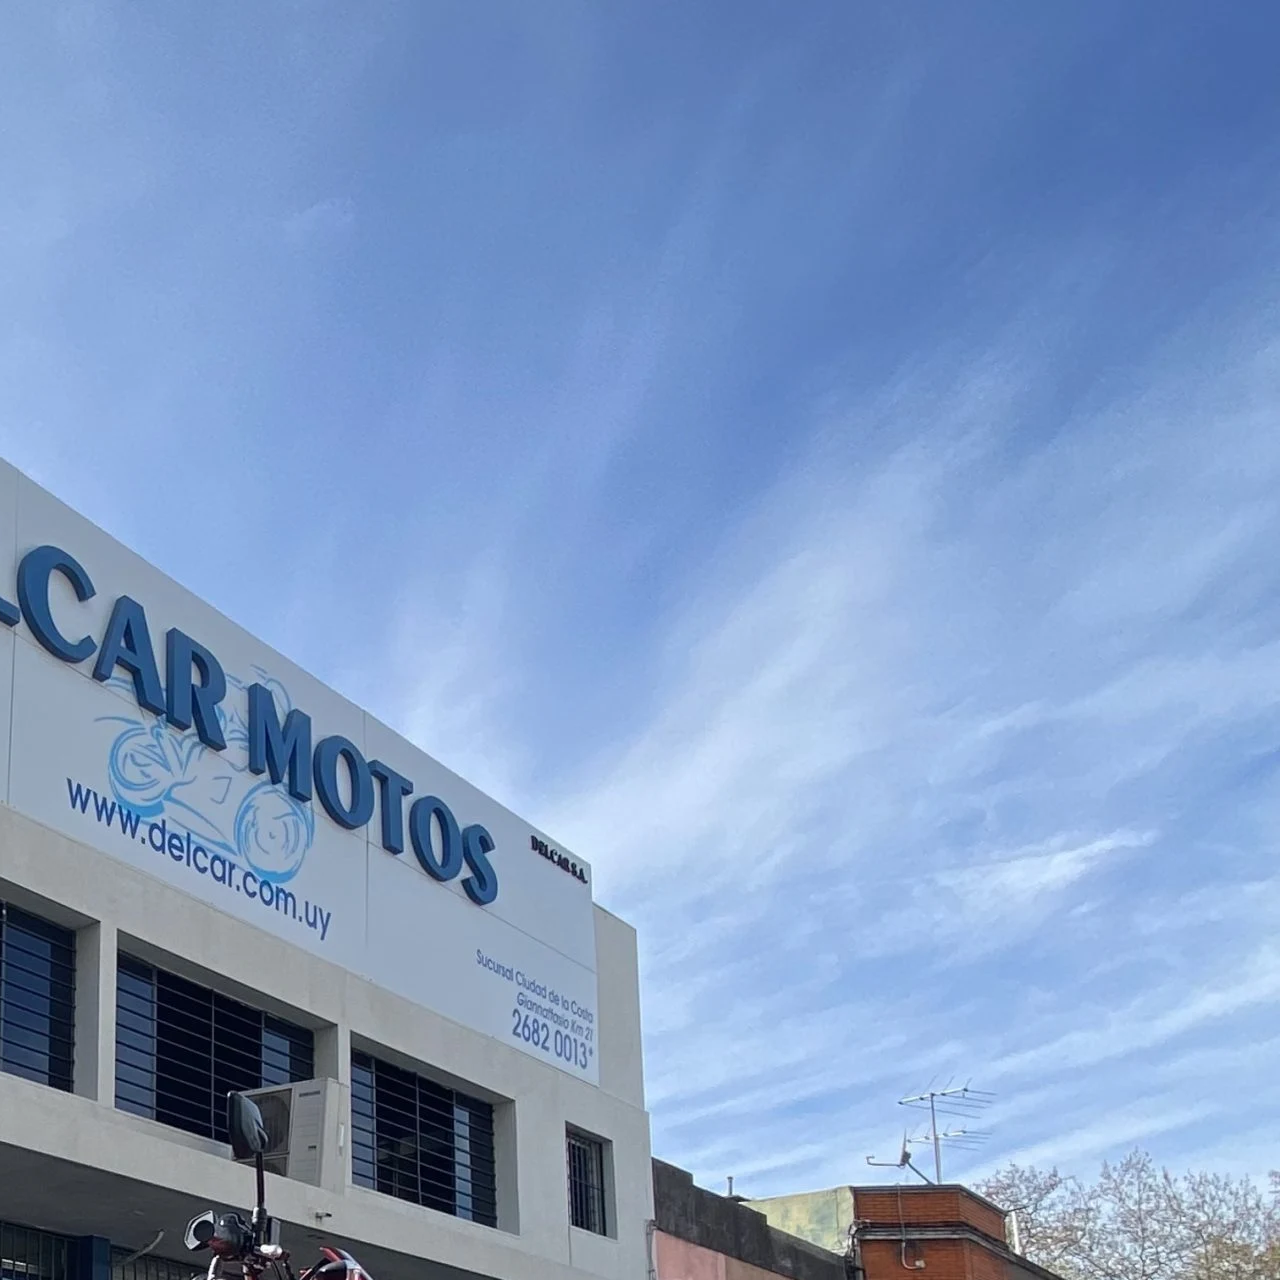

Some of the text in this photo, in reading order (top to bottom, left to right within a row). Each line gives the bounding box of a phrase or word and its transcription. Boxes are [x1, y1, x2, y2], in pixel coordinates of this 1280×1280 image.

[249, 682, 498, 906] MOTOS
[67, 778, 331, 941] www.delcar.com.uy
[476, 949, 594, 1023] Sucursal Ciudad de la Costa
[512, 1008, 550, 1052] 2682
